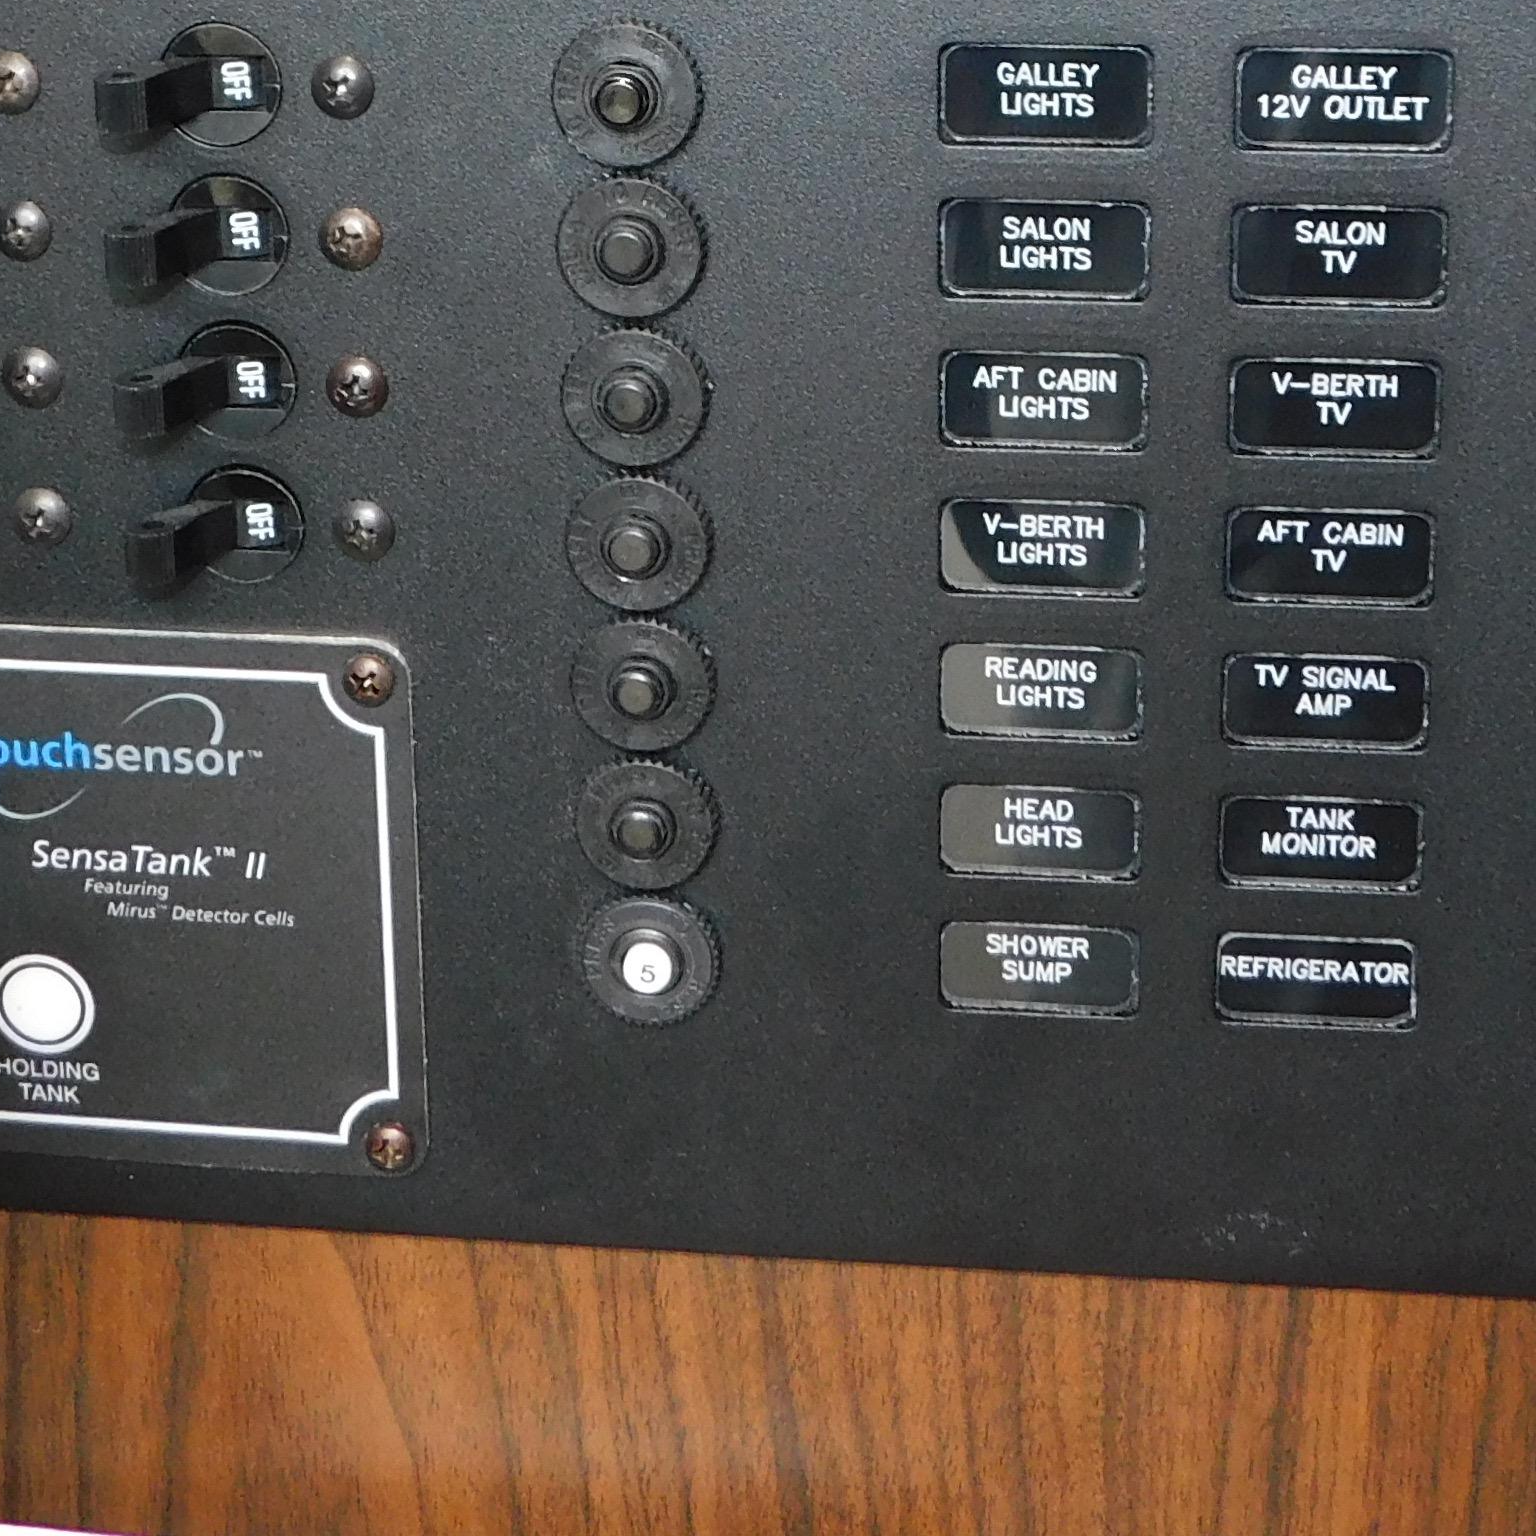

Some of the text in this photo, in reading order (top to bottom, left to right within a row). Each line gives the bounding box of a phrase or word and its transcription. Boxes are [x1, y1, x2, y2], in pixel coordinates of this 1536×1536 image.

[220, 61, 253, 101] OFF
[996, 61, 1100, 88] GALLEY
[1291, 64, 1398, 91] GALLEY
[1000, 91, 1095, 118] LIGHTS
[1257, 93, 1430, 121] 12V OUTLET
[229, 211, 261, 251] OFF
[1002, 215, 1091, 242] SALON
[1295, 219, 1386, 246] SALON
[999, 244, 1092, 271] LIGHTS
[1320, 249, 1358, 274] TV
[236, 361, 266, 399] OFF
[972, 365, 1117, 393] AFT CABIN
[998, 394, 1090, 421] LIGHTS
[1315, 400, 1353, 425] TV
[245, 502, 275, 541] OFF
[1257, 519, 1404, 547] AFT CABIN
[997, 540, 1088, 567] LIGHTS
[1310, 548, 1347, 573] TV
[984, 655, 1097, 684] READING
[1254, 663, 1396, 692] TV SIGNAL
[996, 683, 1085, 710] LIGHTS
[1295, 692, 1352, 717] AMP
[1004, 796, 1074, 822] HEAD
[1285, 806, 1355, 831] TANK
[995, 822, 1083, 849] LIGHTS
[1261, 831, 1376, 859] MONITOR
[84, 877, 170, 900] Featuring
[172, 905, 250, 925] Detector
[254, 910, 296, 927] Cells
[985, 933, 1090, 960] SHOWER
[640, 964, 656, 984] 5
[1001, 959, 1073, 984] SUMP
[1220, 955, 1410, 985] REFRIGERATOR
[18, 1082, 80, 1104] TANK
